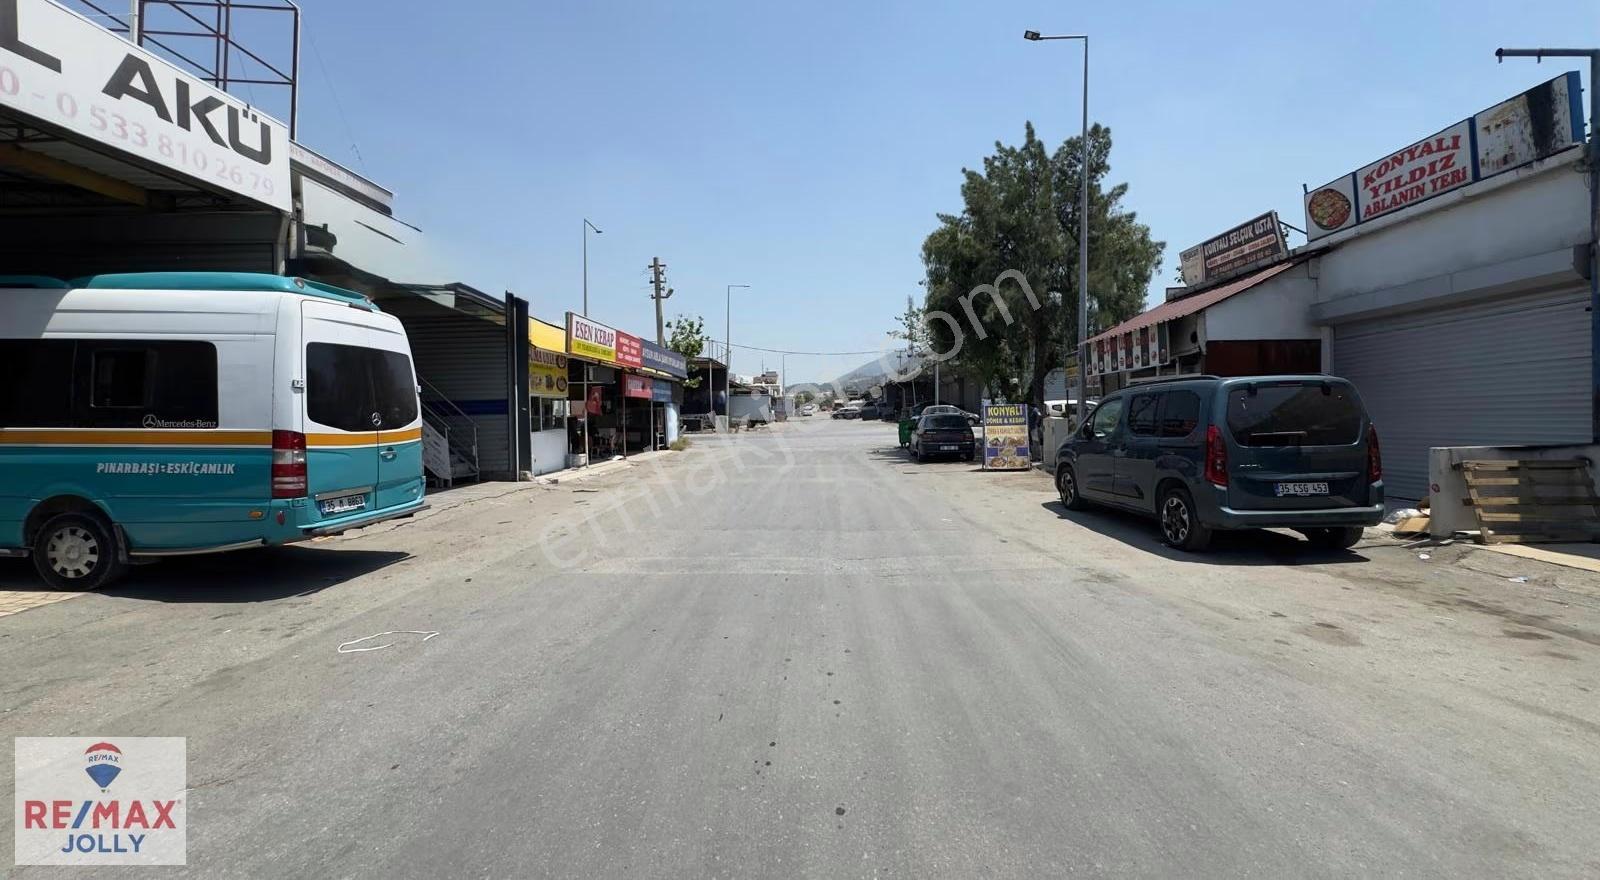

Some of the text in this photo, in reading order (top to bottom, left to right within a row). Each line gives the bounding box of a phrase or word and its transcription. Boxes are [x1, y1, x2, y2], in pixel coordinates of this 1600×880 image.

[102, 53, 272, 166] AKÜ
[56, 91, 78, 118] 0
[89, 106, 150, 150] 533
[157, 135, 208, 173] 810
[215, 155, 244, 187] 26
[249, 170, 275, 198] 79
[1362, 134, 1462, 191] KONYALI
[1368, 153, 1456, 200] YILDIZ
[1363, 186, 1425, 218] ABLANIN
[1204, 236, 1229, 256] KONYALI
[1229, 224, 1254, 245] SELÇUK
[1254, 217, 1273, 234] USTA
[575, 321, 594, 342] ESEN
[594, 327, 615, 348] KEBAP
[156, 419, 217, 429] Mercedes-Benz
[987, 406, 1023, 417] KONYALI
[1279, 483, 1291, 493] 35
[1312, 483, 1328, 493] 453
[326, 500, 336, 510] 35
